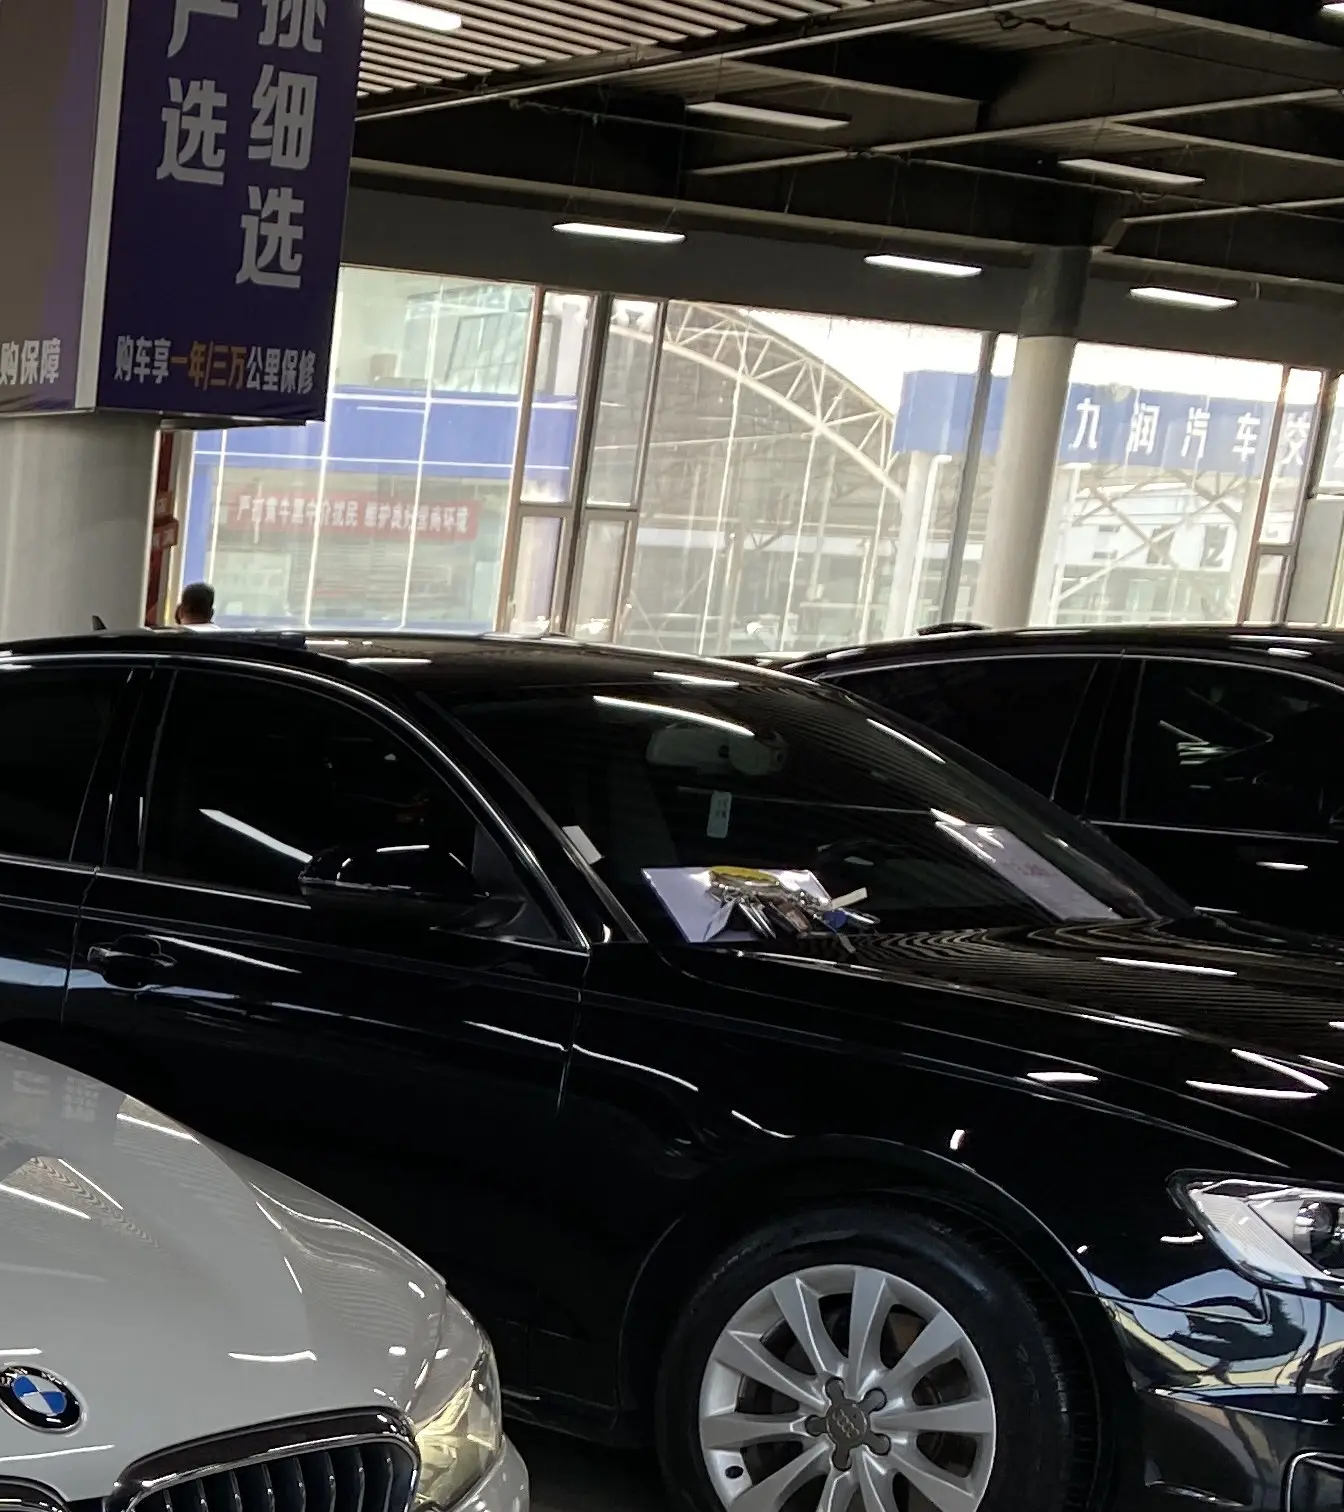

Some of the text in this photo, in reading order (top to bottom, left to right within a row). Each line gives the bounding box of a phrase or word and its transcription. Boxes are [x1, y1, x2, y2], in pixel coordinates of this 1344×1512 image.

[114, 335, 317, 395] 购车享一年/三万公里保修
[1069, 397, 1344, 467] 九润汽车交
